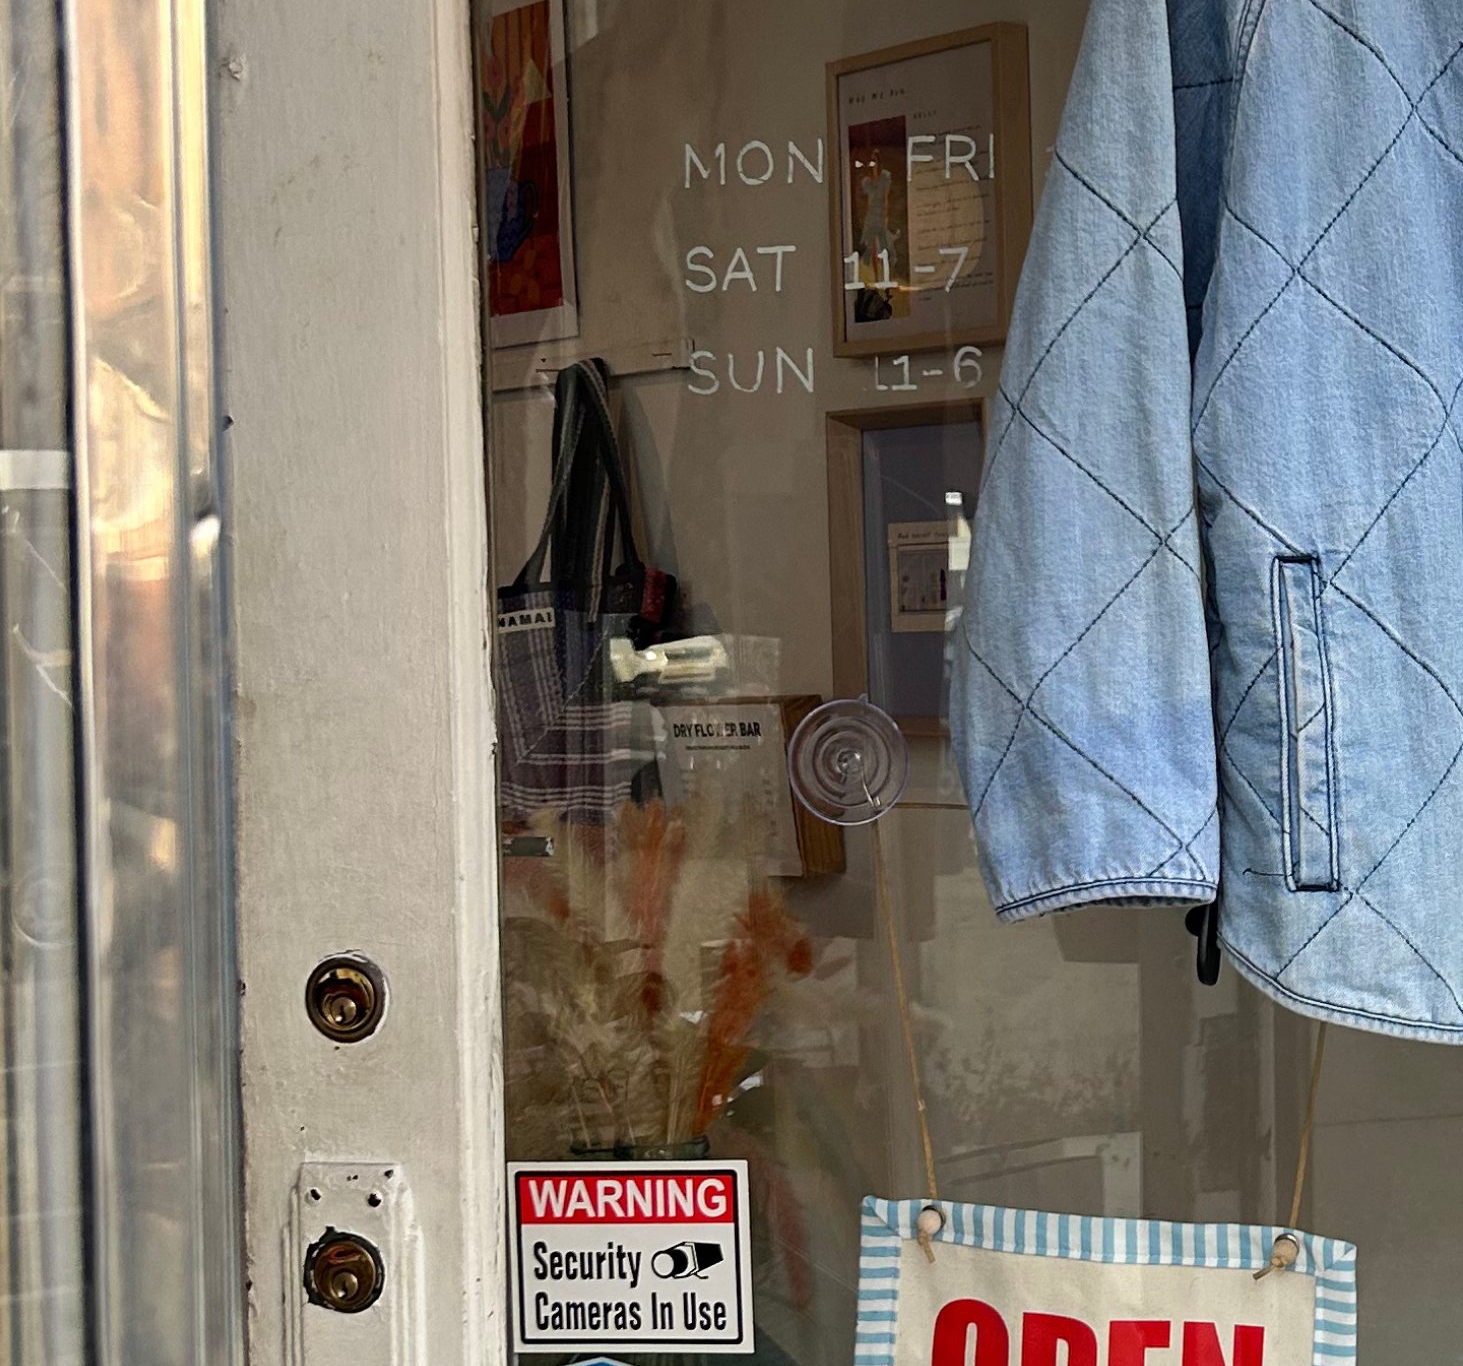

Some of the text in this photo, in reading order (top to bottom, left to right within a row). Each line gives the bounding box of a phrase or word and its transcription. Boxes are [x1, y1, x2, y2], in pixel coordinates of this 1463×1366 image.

[684, 133, 995, 188] MON FRI
[686, 245, 796, 292] SAT
[688, 347, 815, 395] SUN
[673, 723, 693, 738] DRY
[738, 721, 762, 737] BAR
[529, 1178, 727, 1219] WARNING
[533, 1241, 642, 1288] Security
[535, 1292, 727, 1331] Cameras In Use
